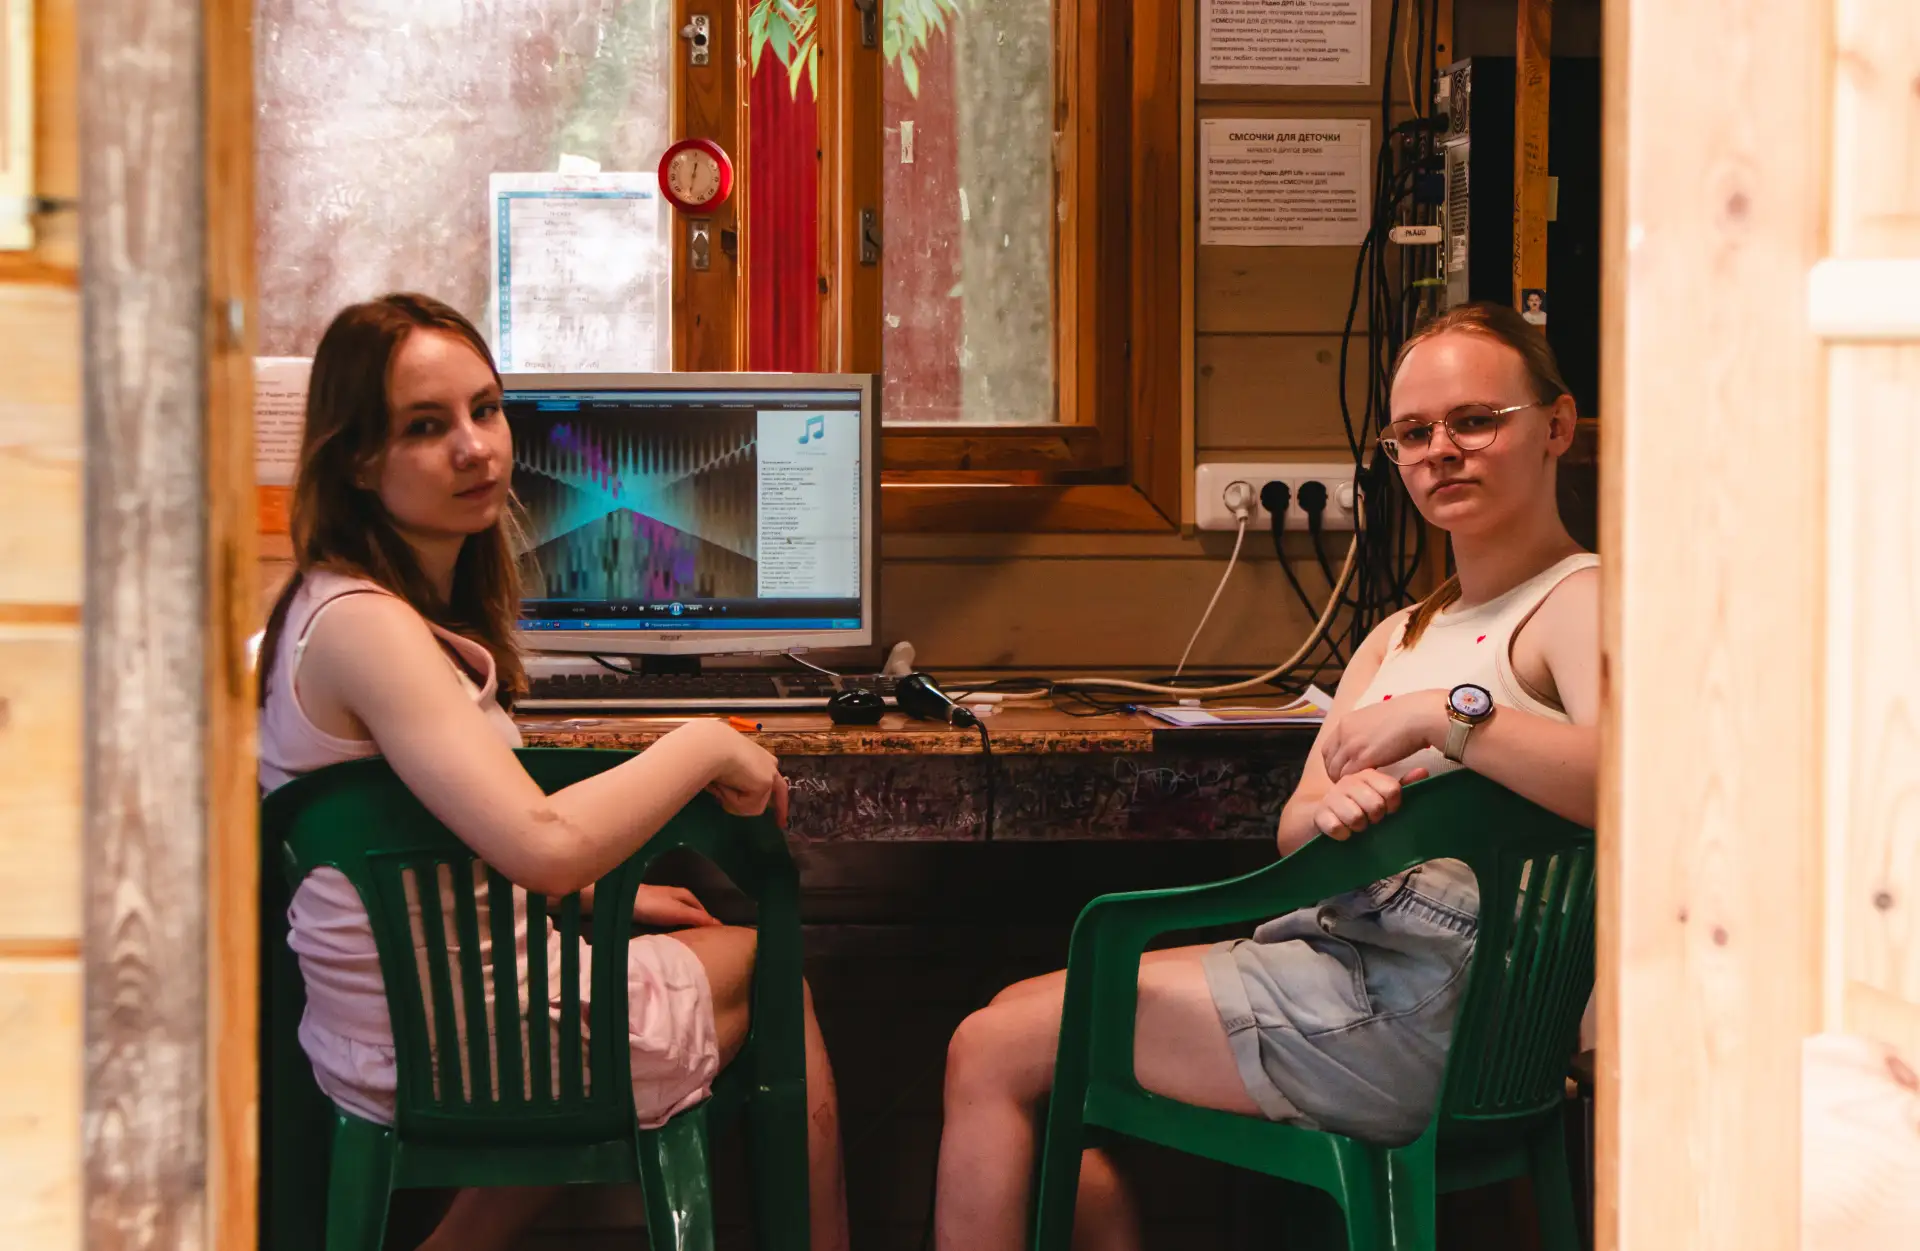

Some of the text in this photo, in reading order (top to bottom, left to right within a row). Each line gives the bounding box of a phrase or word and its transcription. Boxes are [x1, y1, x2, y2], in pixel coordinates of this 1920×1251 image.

[1228, 133, 1341, 142] СМСОЧКИ ДЛЯ ДЕТОЧКИ
